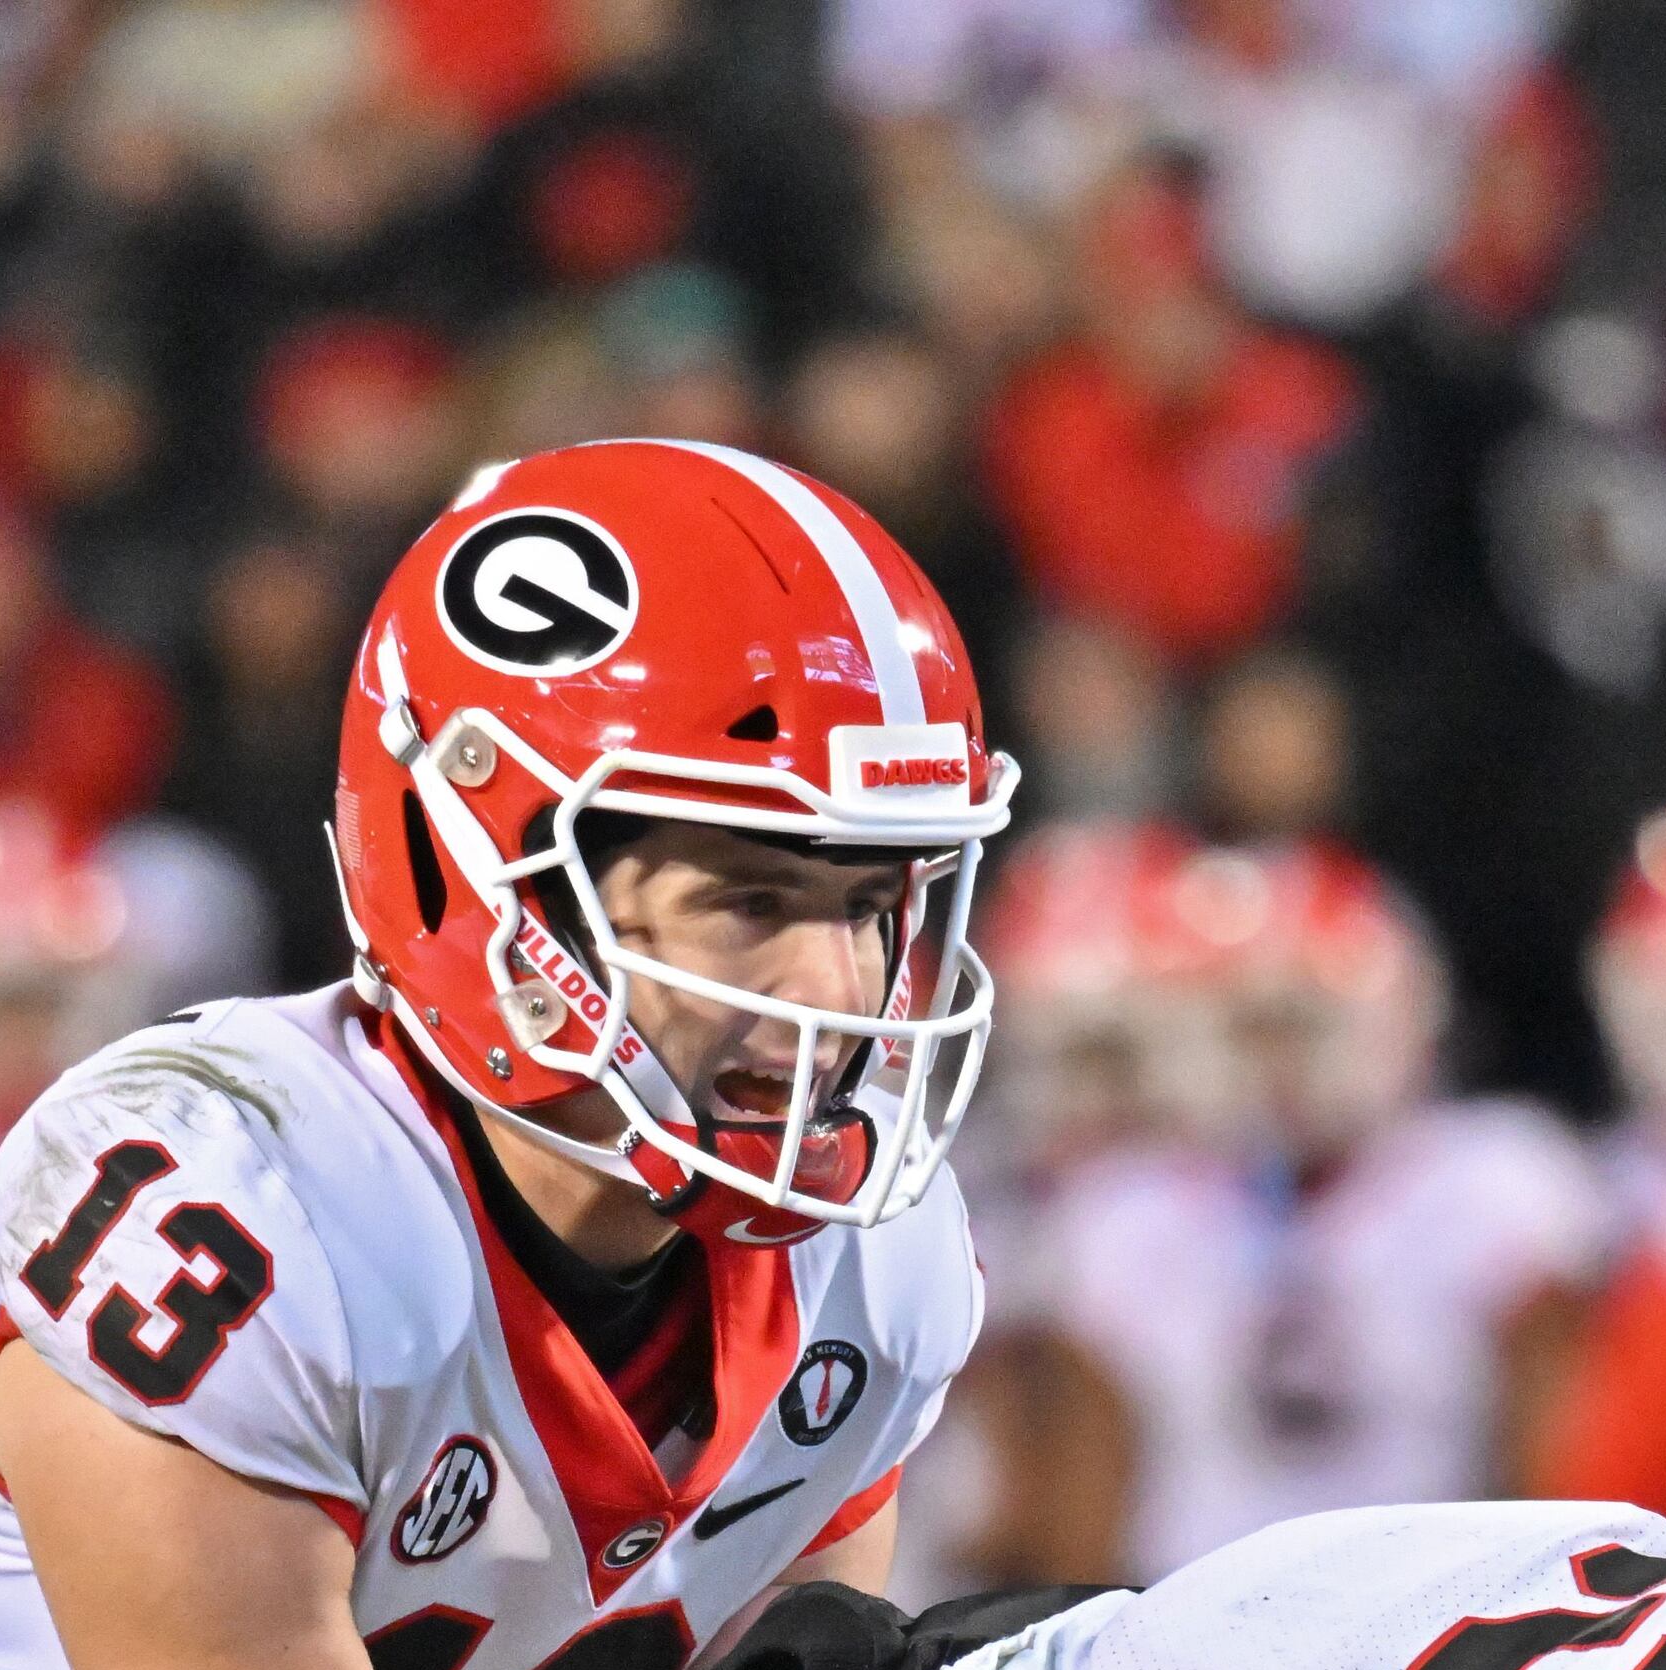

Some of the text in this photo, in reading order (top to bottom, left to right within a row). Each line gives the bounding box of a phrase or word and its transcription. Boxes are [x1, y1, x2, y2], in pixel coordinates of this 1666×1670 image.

[440, 511, 632, 669] G
[859, 758, 969, 790] DAWGS
[493, 903, 645, 1066] ULLDOS
[18, 1138, 276, 1408] 13
[401, 1446, 491, 1557] SEC
